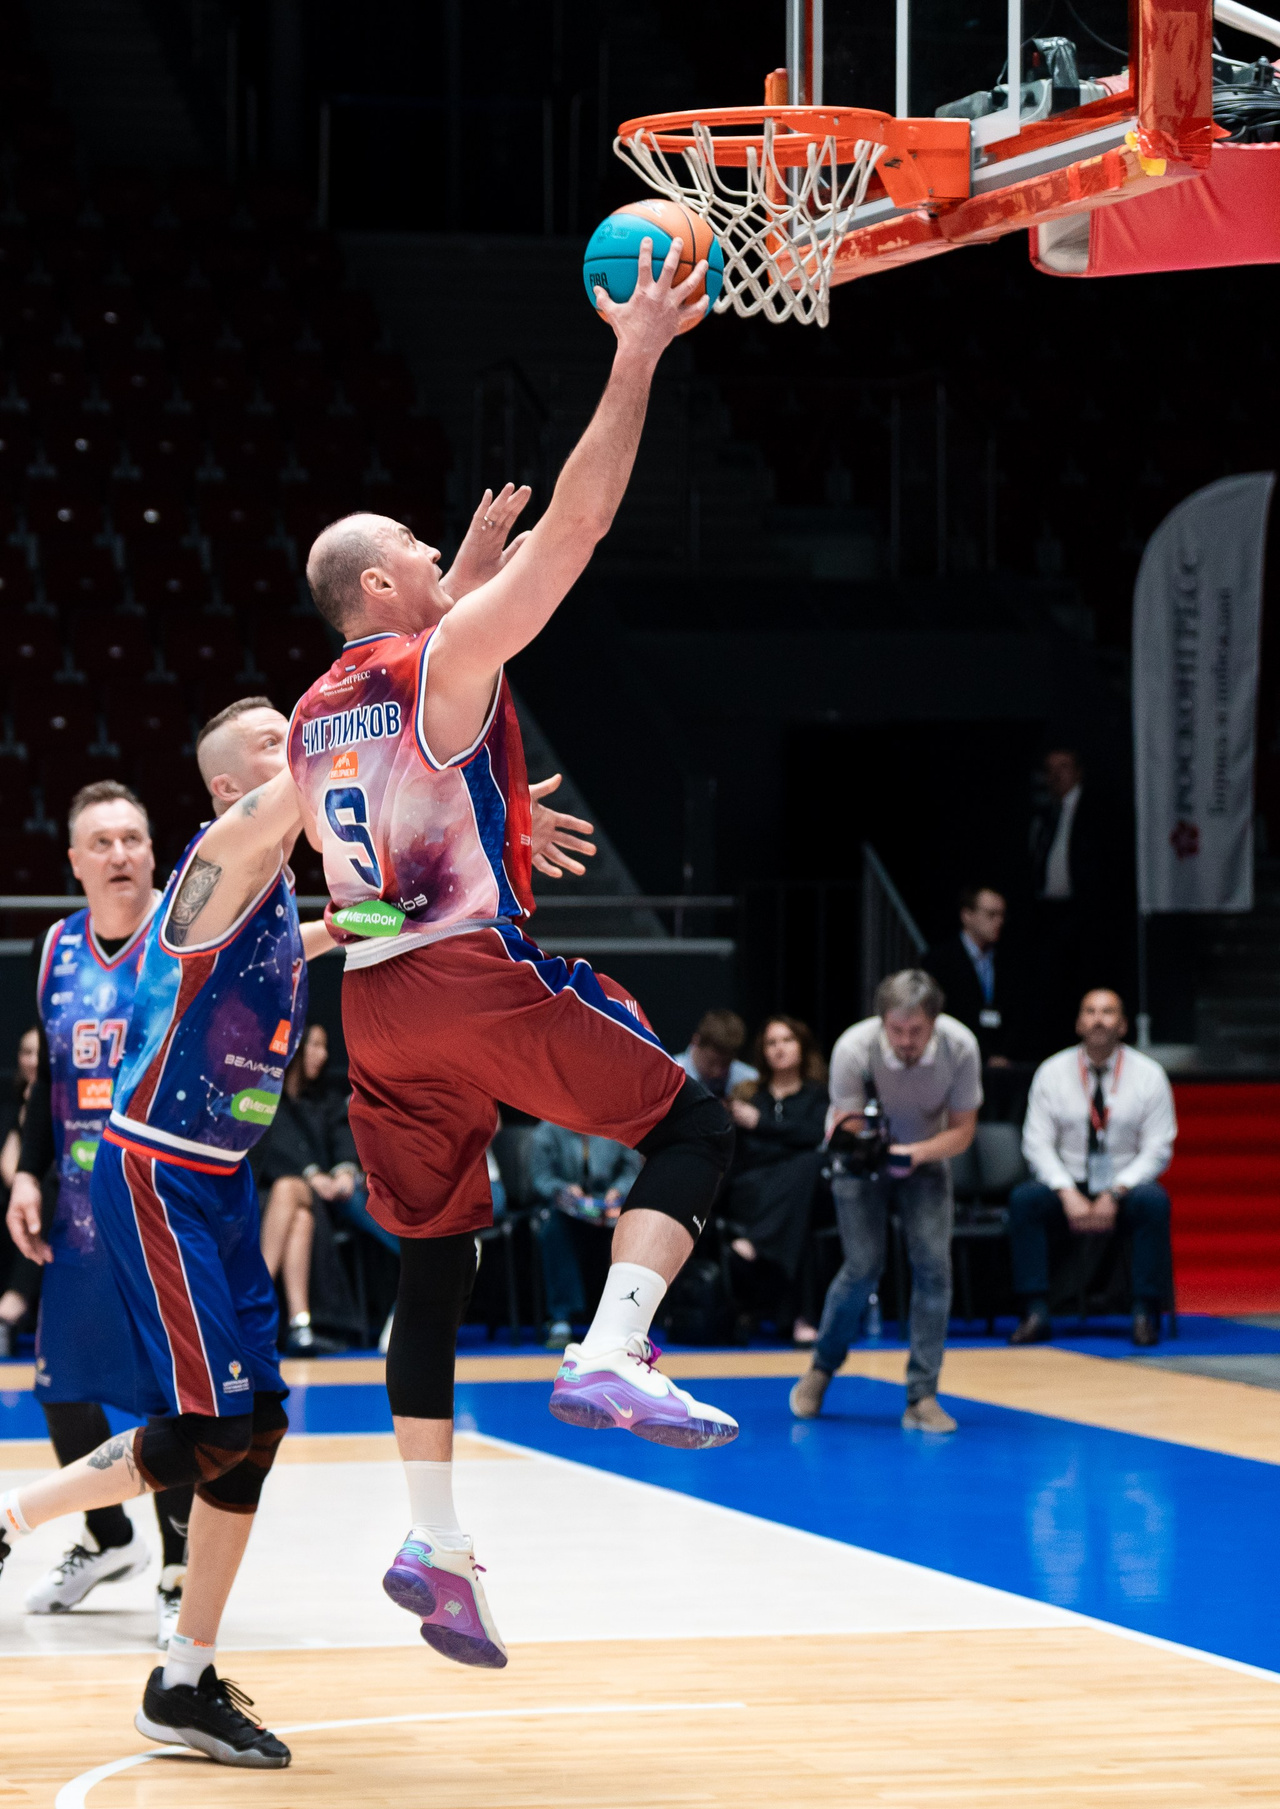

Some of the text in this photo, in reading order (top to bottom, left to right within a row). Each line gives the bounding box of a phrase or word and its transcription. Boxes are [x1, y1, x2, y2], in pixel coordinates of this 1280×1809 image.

[302, 701, 401, 757] ЧИГЛИКОВ
[322, 782, 383, 892] 9
[347, 911, 396, 926] МЕГАФОН
[72, 1019, 128, 1069] 67
